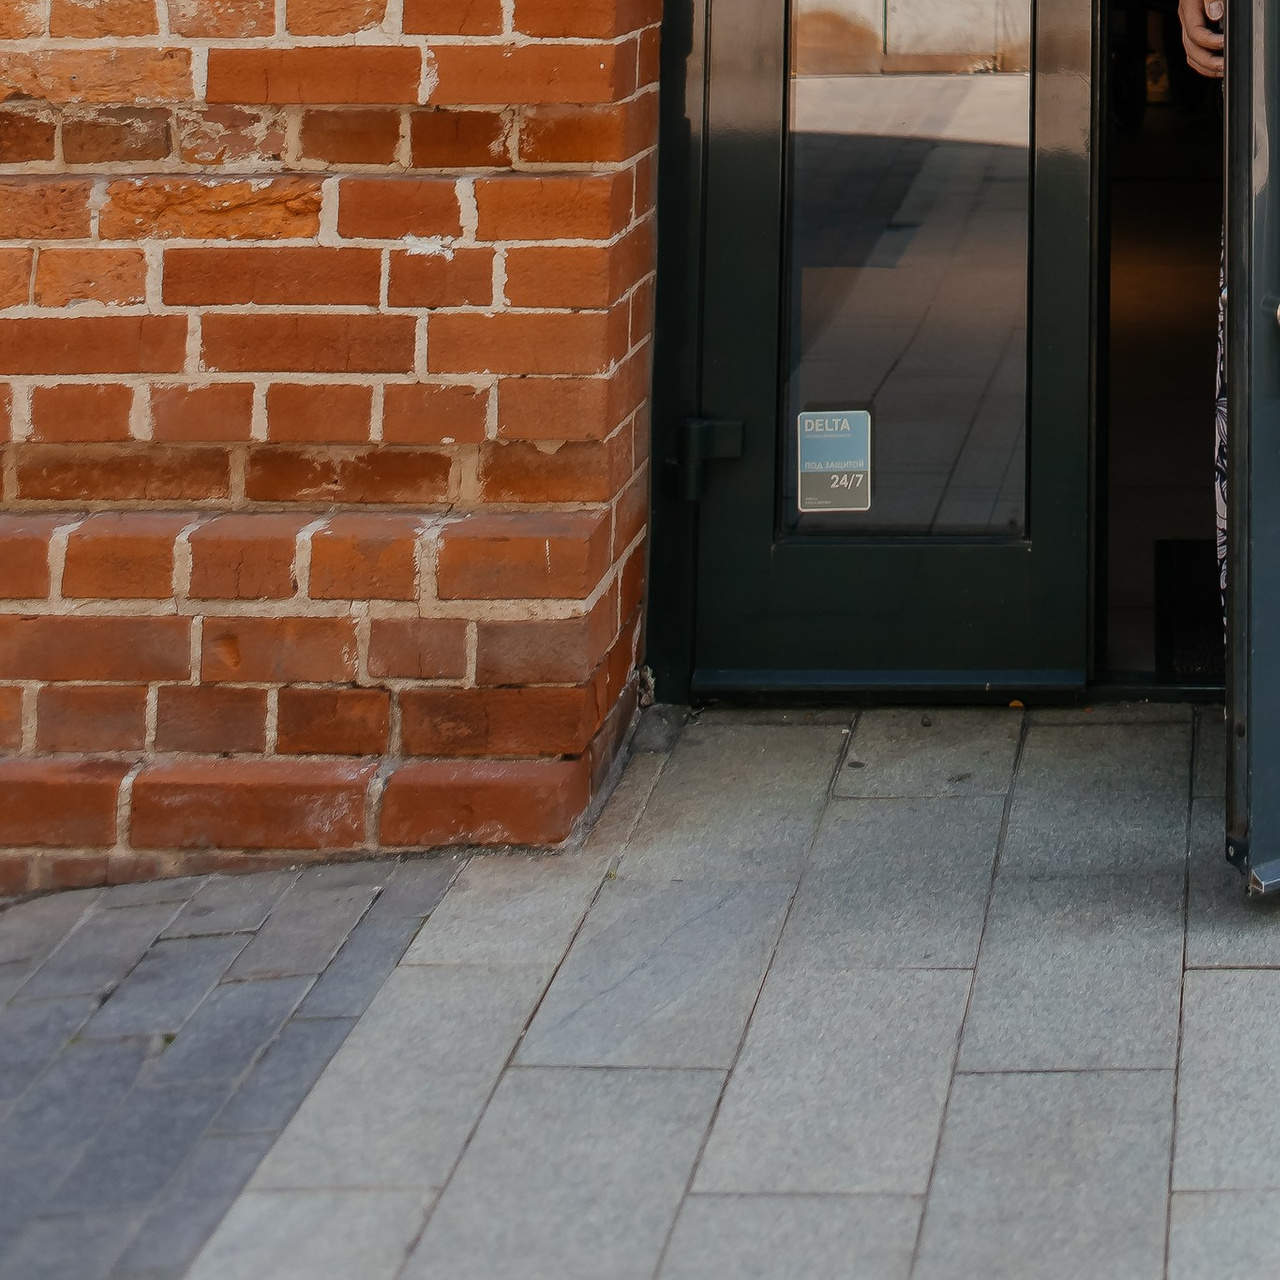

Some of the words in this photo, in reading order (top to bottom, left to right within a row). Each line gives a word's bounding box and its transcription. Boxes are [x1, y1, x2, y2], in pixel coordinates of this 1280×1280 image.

[804, 418, 850, 432] DELTA
[804, 462, 823, 470] ПОД
[826, 459, 864, 470] ЗАЩИТОЙ
[830, 474, 864, 490] 24/7
